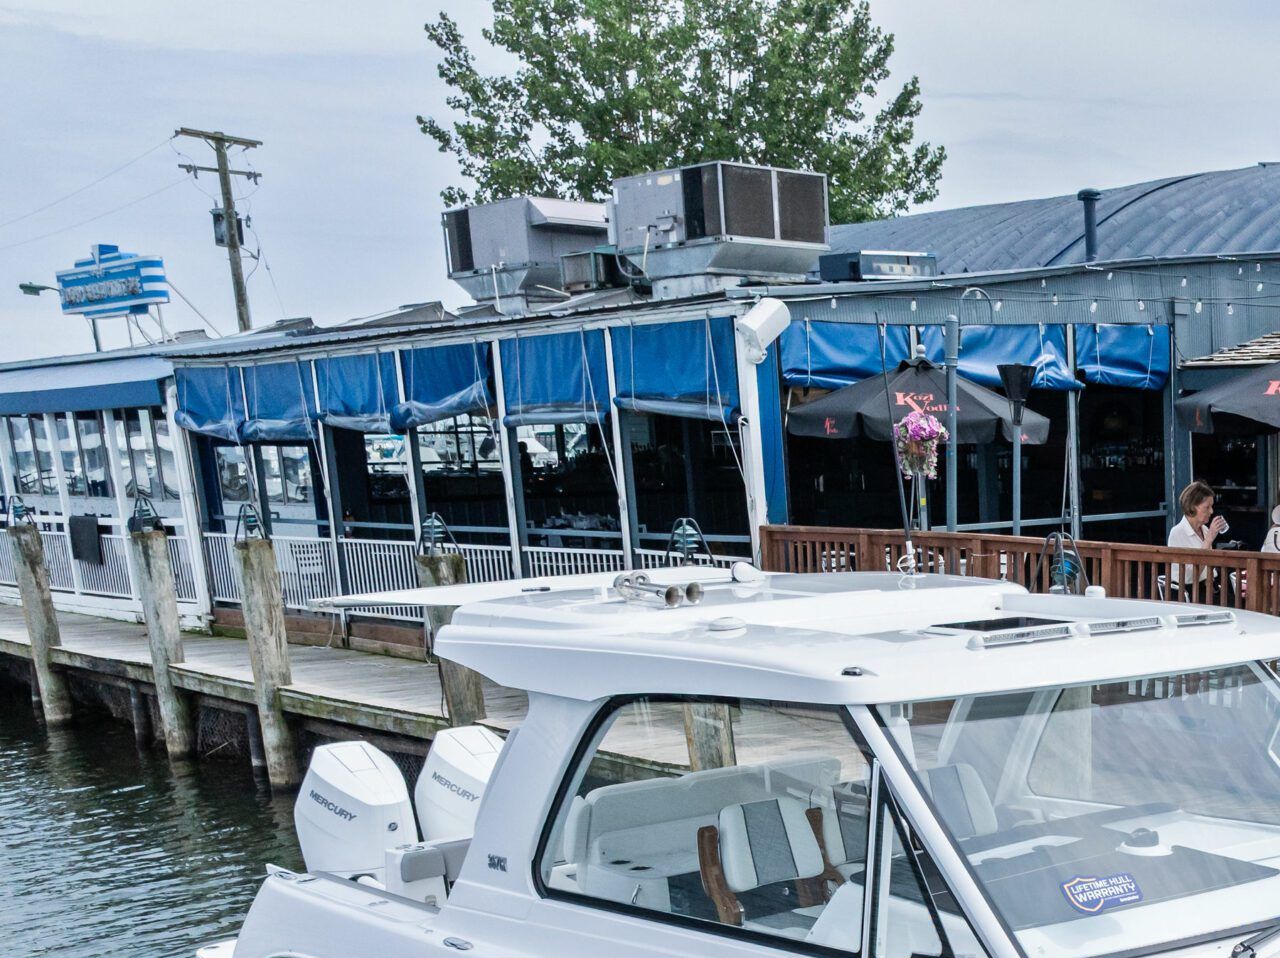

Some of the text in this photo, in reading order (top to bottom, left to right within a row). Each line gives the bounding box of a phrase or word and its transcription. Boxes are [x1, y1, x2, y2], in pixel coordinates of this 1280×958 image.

[432, 771, 481, 802] MERCURY
[309, 789, 357, 822] MERCURY
[1070, 875, 1133, 894] LIFETIME HULL
[1074, 883, 1136, 903] WARRANTY
